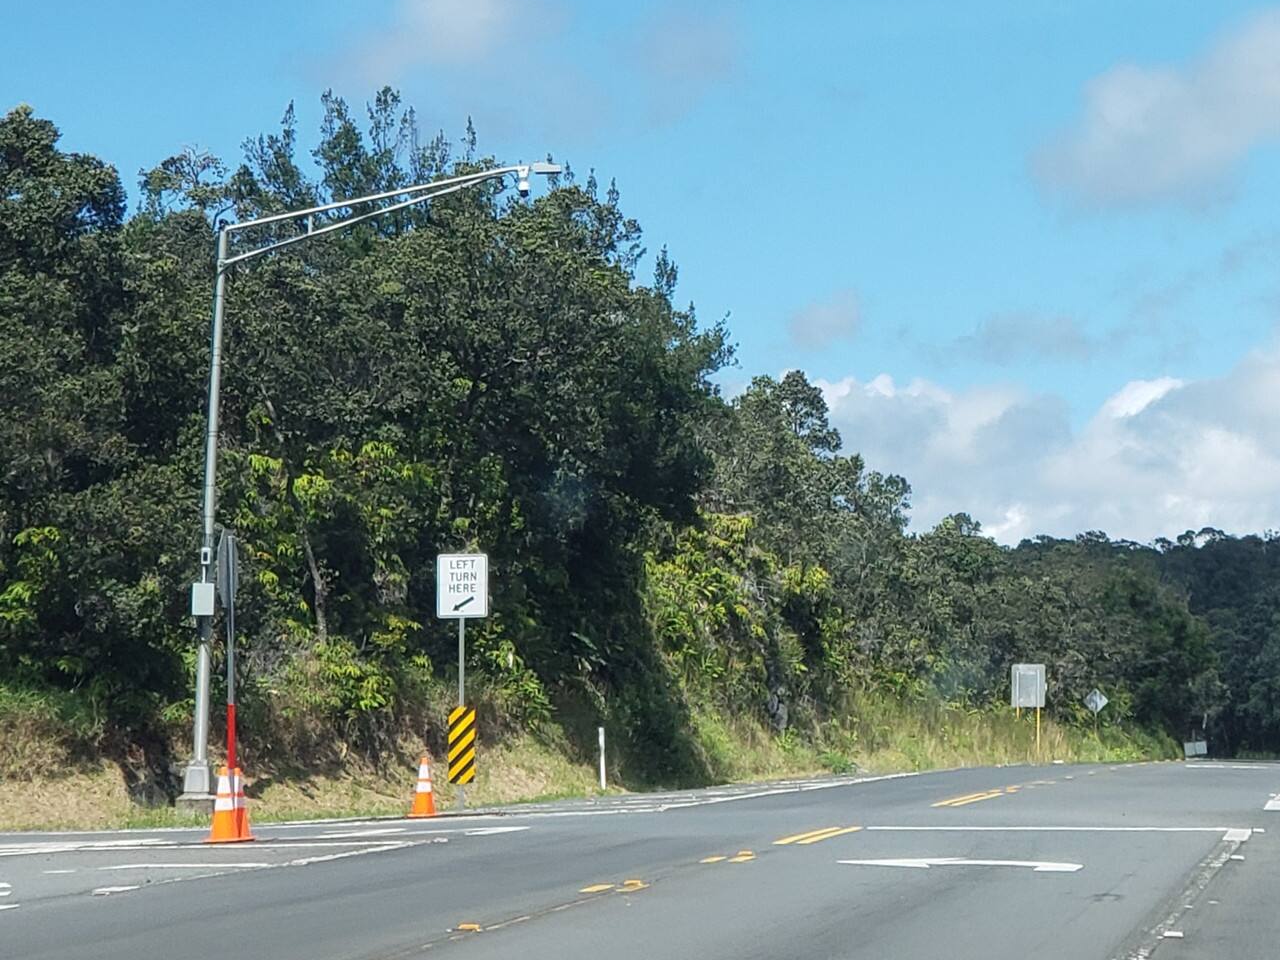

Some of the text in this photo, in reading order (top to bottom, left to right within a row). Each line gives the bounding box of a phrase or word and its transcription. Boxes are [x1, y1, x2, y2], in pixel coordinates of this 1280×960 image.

[449, 559, 476, 570] LEFT
[449, 571, 478, 582] TURN
[448, 583, 477, 593] HERE
